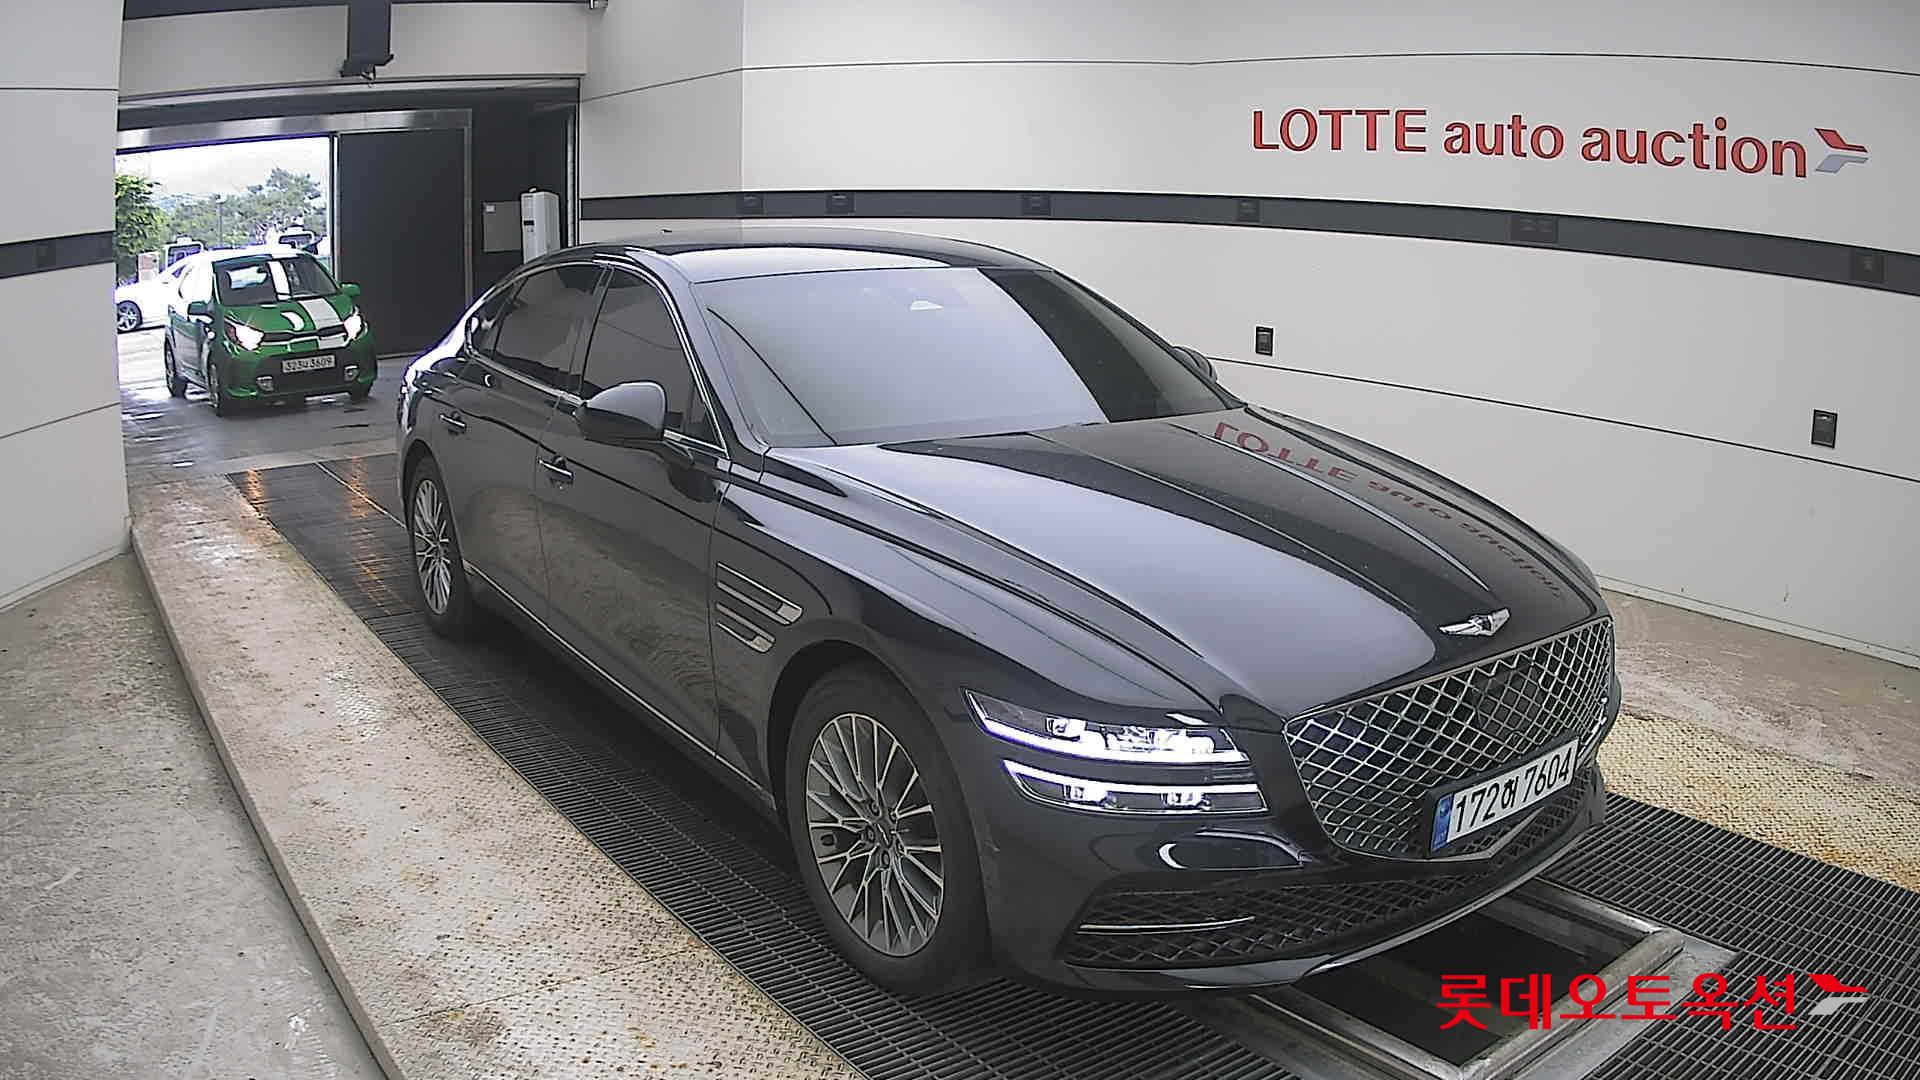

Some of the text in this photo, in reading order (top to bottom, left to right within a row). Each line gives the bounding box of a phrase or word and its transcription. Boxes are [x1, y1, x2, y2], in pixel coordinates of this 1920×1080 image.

[1253, 108, 1808, 178] LOTTE auto auction
